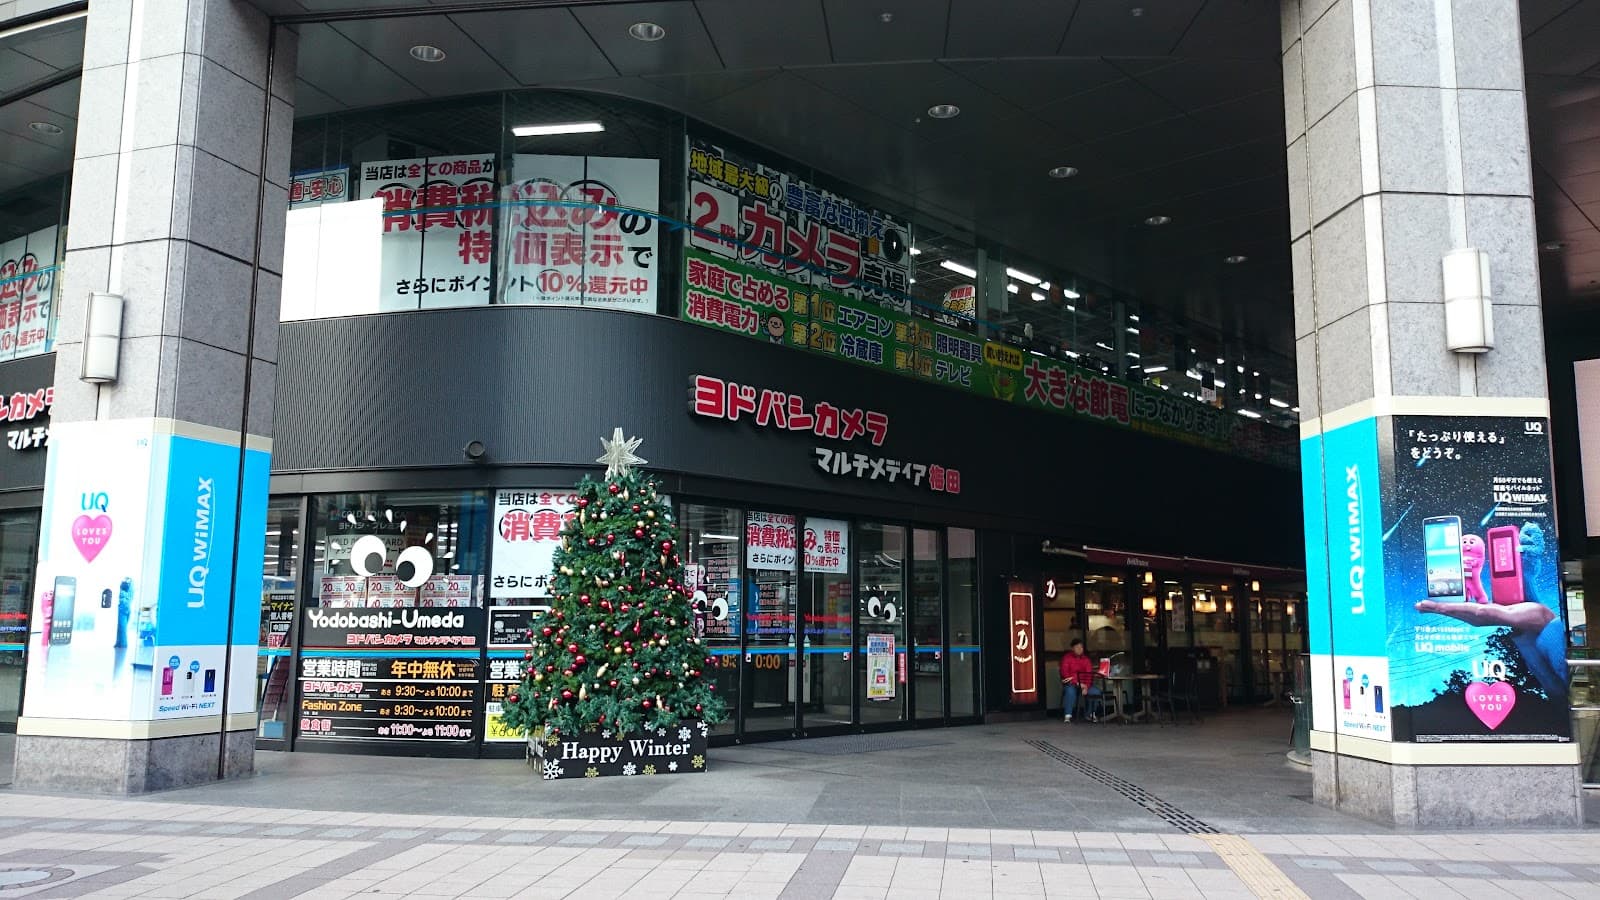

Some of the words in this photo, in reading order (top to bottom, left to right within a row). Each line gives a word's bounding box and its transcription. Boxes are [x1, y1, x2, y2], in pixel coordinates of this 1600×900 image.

[458, 229, 653, 268] 特価表示で
[687, 260, 790, 311] 家庭で占める
[687, 293, 759, 334] 消費電力
[838, 305, 893, 337] エアコン
[840, 334, 884, 365] 冷蔵庫
[935, 331, 983, 365] 照明器具
[936, 360, 972, 387] テレビ
[695, 374, 889, 447] ヨドバシカメラ
[1525, 422, 1542, 432] UQ
[1408, 430, 1505, 445] 「たっぷり使える」
[1410, 447, 1461, 460] をどうぞ。
[815, 447, 961, 494] マルチメディア梅田
[81, 492, 109, 512] UQ
[1493, 492, 1512, 503] UQ
[1512, 494, 1548, 502] WiMAX
[191, 476, 213, 560] WiMAX
[1346, 465, 1362, 557] WiMAX
[77, 527, 107, 537] LOVES
[502, 512, 576, 542] 消費
[81, 537, 101, 546] YOU
[187, 565, 209, 608] UQ
[494, 575, 548, 588] さらにポ
[1349, 566, 1366, 614] UQ
[308, 609, 465, 630] Yodobashi-Umeda
[346, 634, 412, 645] ヨドバシカメラ
[302, 659, 361, 678] 営業時間
[391, 660, 456, 679] 年中無休
[1472, 660, 1507, 680] UQ
[303, 682, 363, 693] ヨドバシカメラ
[158, 703, 181, 713] Speed
[198, 701, 216, 710] NEXT
[302, 700, 337, 712] Fashion
[339, 701, 362, 713] Zone
[1472, 694, 1508, 702] LOVES
[1480, 703, 1502, 711] YOU
[561, 741, 623, 764] Happy
[629, 739, 690, 757] Winter
